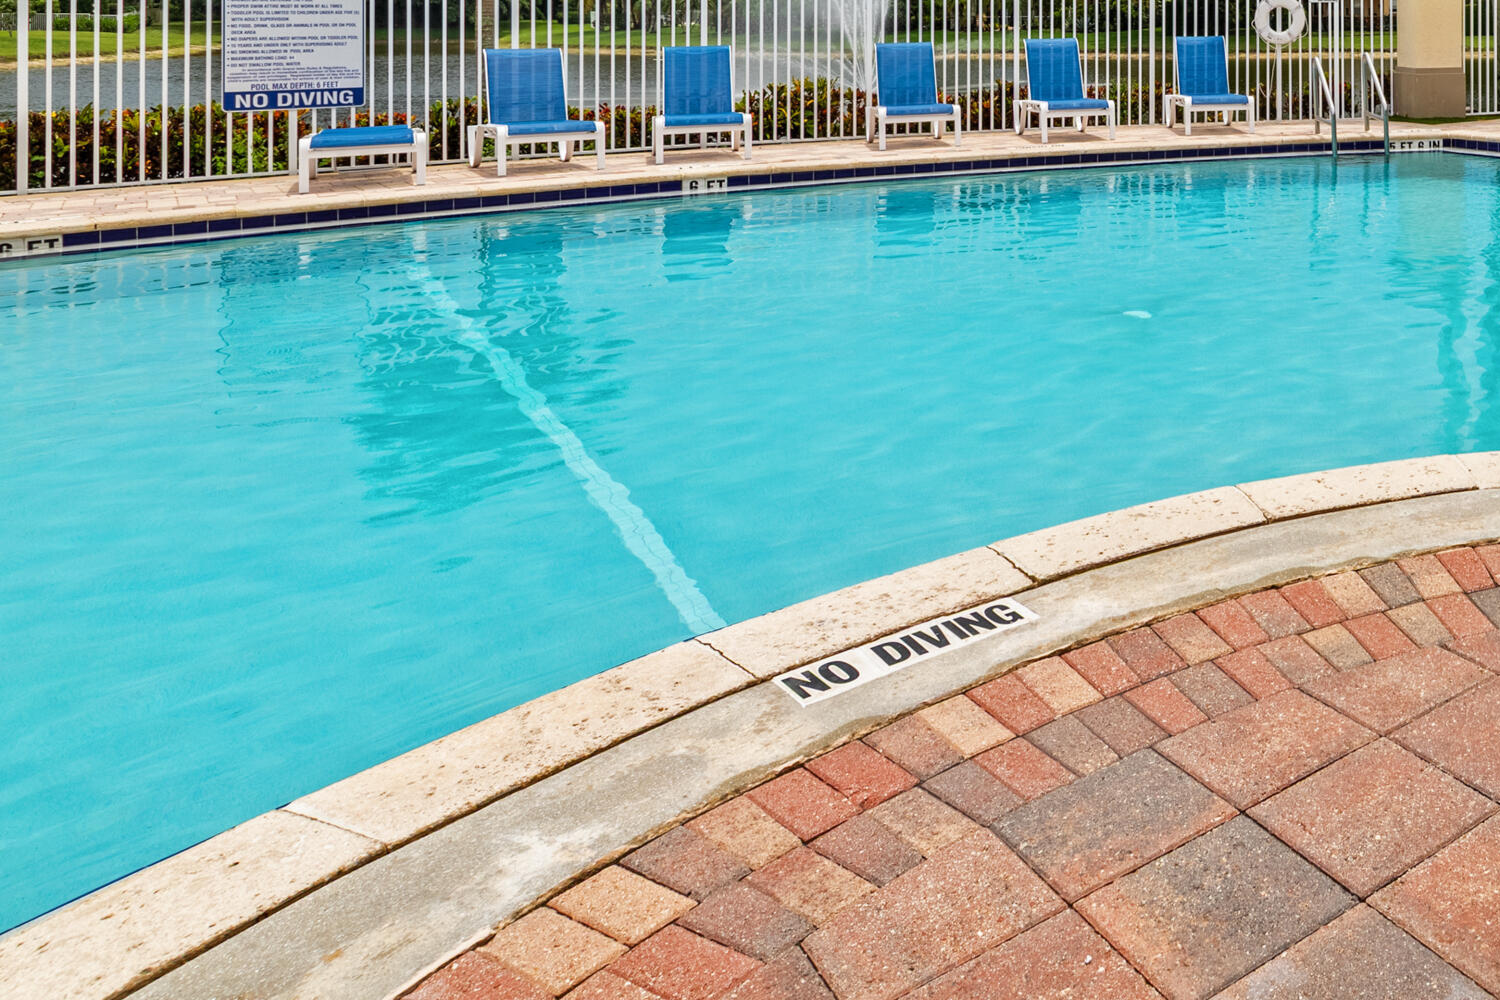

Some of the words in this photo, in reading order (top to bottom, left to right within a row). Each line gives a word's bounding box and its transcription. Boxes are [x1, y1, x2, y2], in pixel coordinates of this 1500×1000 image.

[235, 94, 268, 108] NO
[277, 90, 354, 107] DIVING
[1429, 140, 1440, 148] IN
[690, 180, 698, 190] 6
[707, 180, 725, 188] FT
[28, 238, 59, 250] FT
[782, 660, 860, 699] NO
[870, 604, 1024, 666] DIVING
